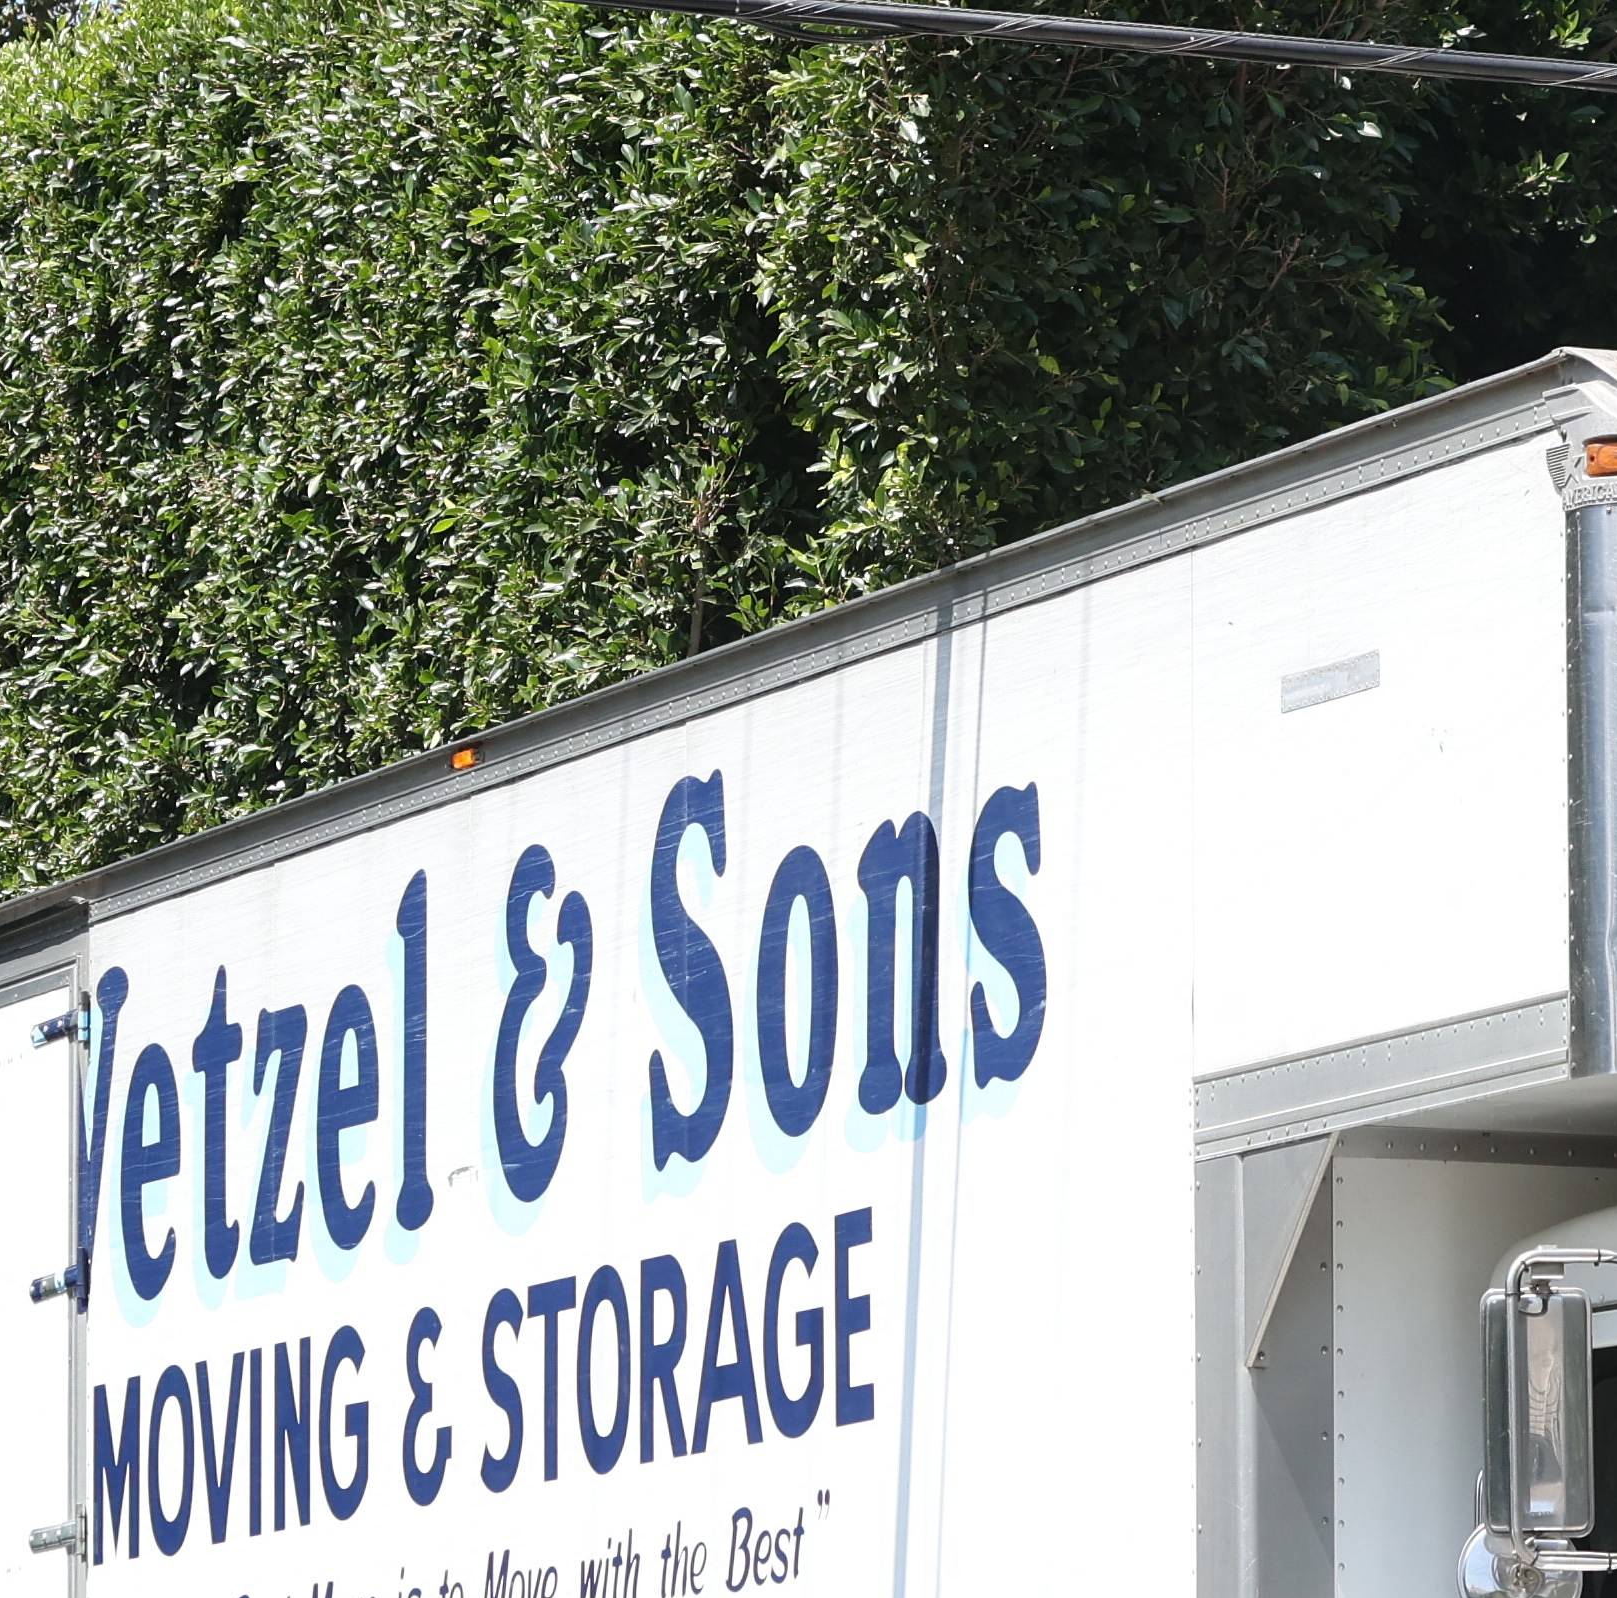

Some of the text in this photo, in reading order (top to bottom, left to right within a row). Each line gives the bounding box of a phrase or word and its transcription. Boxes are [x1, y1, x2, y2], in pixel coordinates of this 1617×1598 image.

[492, 844, 594, 1203] &
[648, 768, 1048, 1173] Sons
[93, 1206, 876, 1567] MOVING & STORAGE
